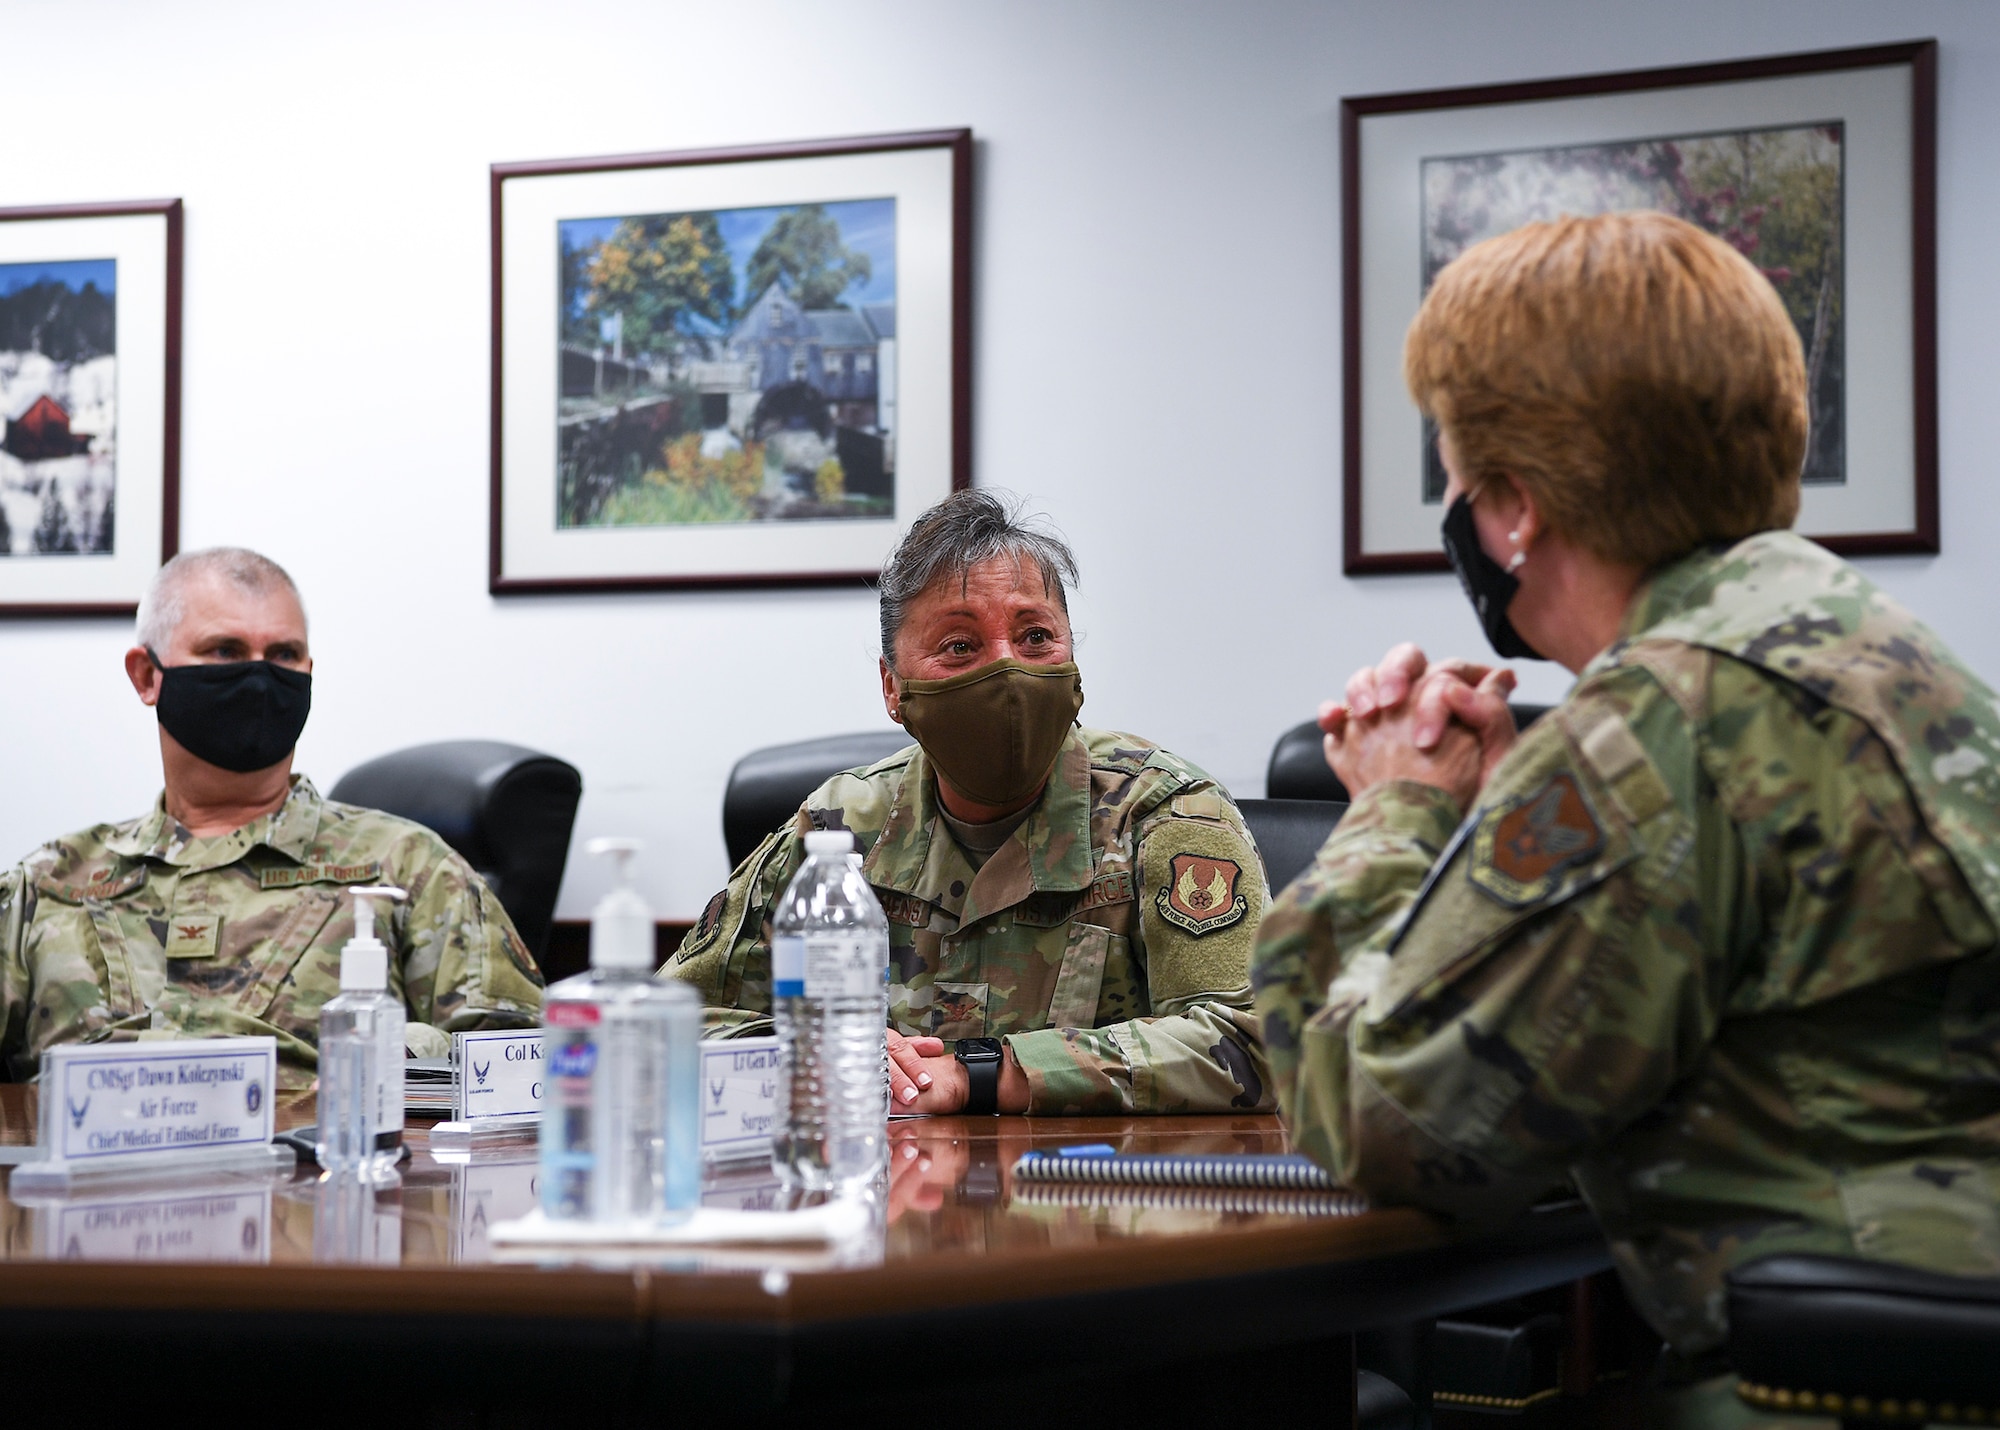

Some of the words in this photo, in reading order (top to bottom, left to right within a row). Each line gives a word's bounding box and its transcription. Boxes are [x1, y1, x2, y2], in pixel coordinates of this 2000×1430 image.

[265, 869, 289, 884] US
[295, 867, 319, 881] AIR
[324, 863, 372, 880] FORCE
[1079, 876, 1131, 907] ORCE
[1167, 910, 1187, 924] FORCE
[1213, 908, 1241, 926] COMMAND
[505, 1044, 526, 1061] Col
[747, 1051, 765, 1070] Gen
[87, 1066, 136, 1093] CMSgt
[138, 1065, 175, 1087] Dawn
[177, 1062, 246, 1088] Kolczynski
[760, 1079, 777, 1098] Air
[139, 1098, 157, 1119] Air
[161, 1096, 198, 1117] Force
[742, 1111, 774, 1133] Surge
[87, 1129, 122, 1150] Chief
[123, 1126, 163, 1148] Medical
[166, 1124, 210, 1144] Enlisted
[211, 1122, 240, 1139] Force
